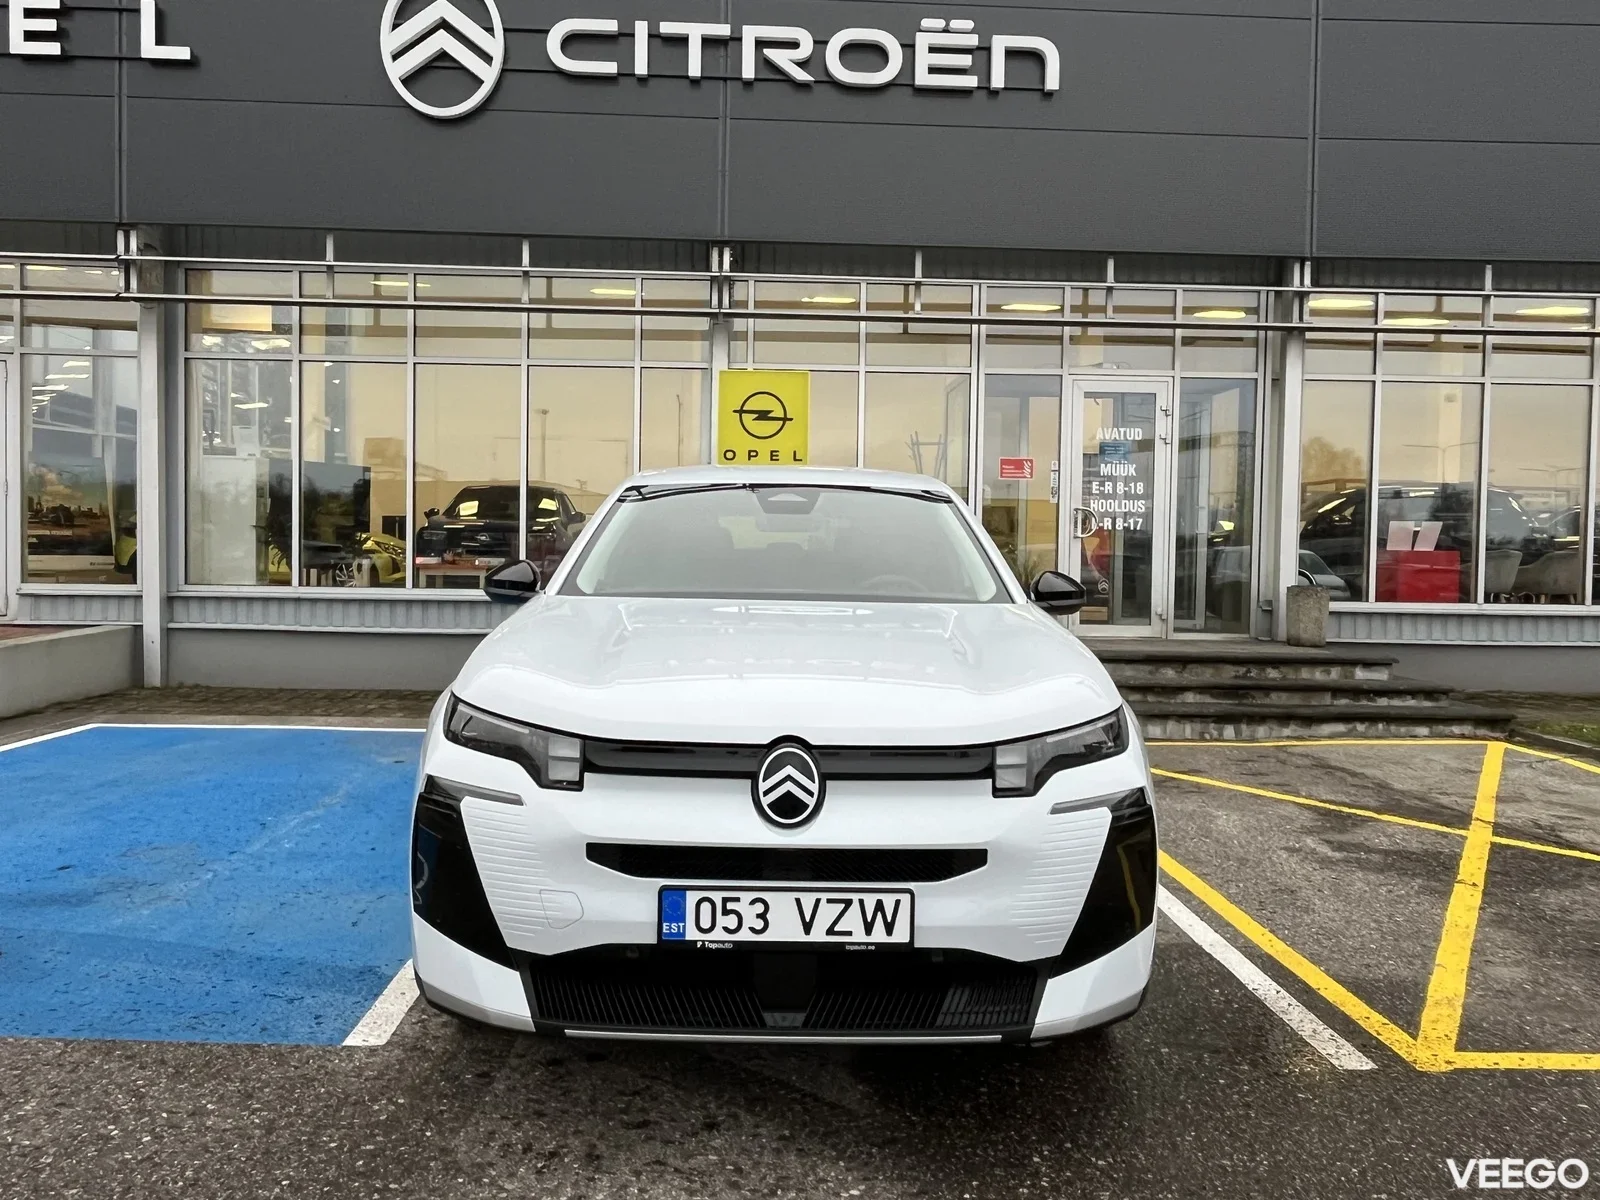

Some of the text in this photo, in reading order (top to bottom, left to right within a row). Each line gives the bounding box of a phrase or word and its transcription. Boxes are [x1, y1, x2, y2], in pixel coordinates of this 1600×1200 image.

[1096, 427, 1143, 440] AVATUD
[723, 449, 803, 462] OPEL
[1100, 460, 1136, 476] MÜÜK
[1092, 482, 1144, 494] E-R 8-18
[1090, 499, 1146, 512] HOOLDUS
[1115, 517, 1143, 530] 8-17
[694, 896, 901, 937] 053 VZW
[663, 922, 685, 933] EST
